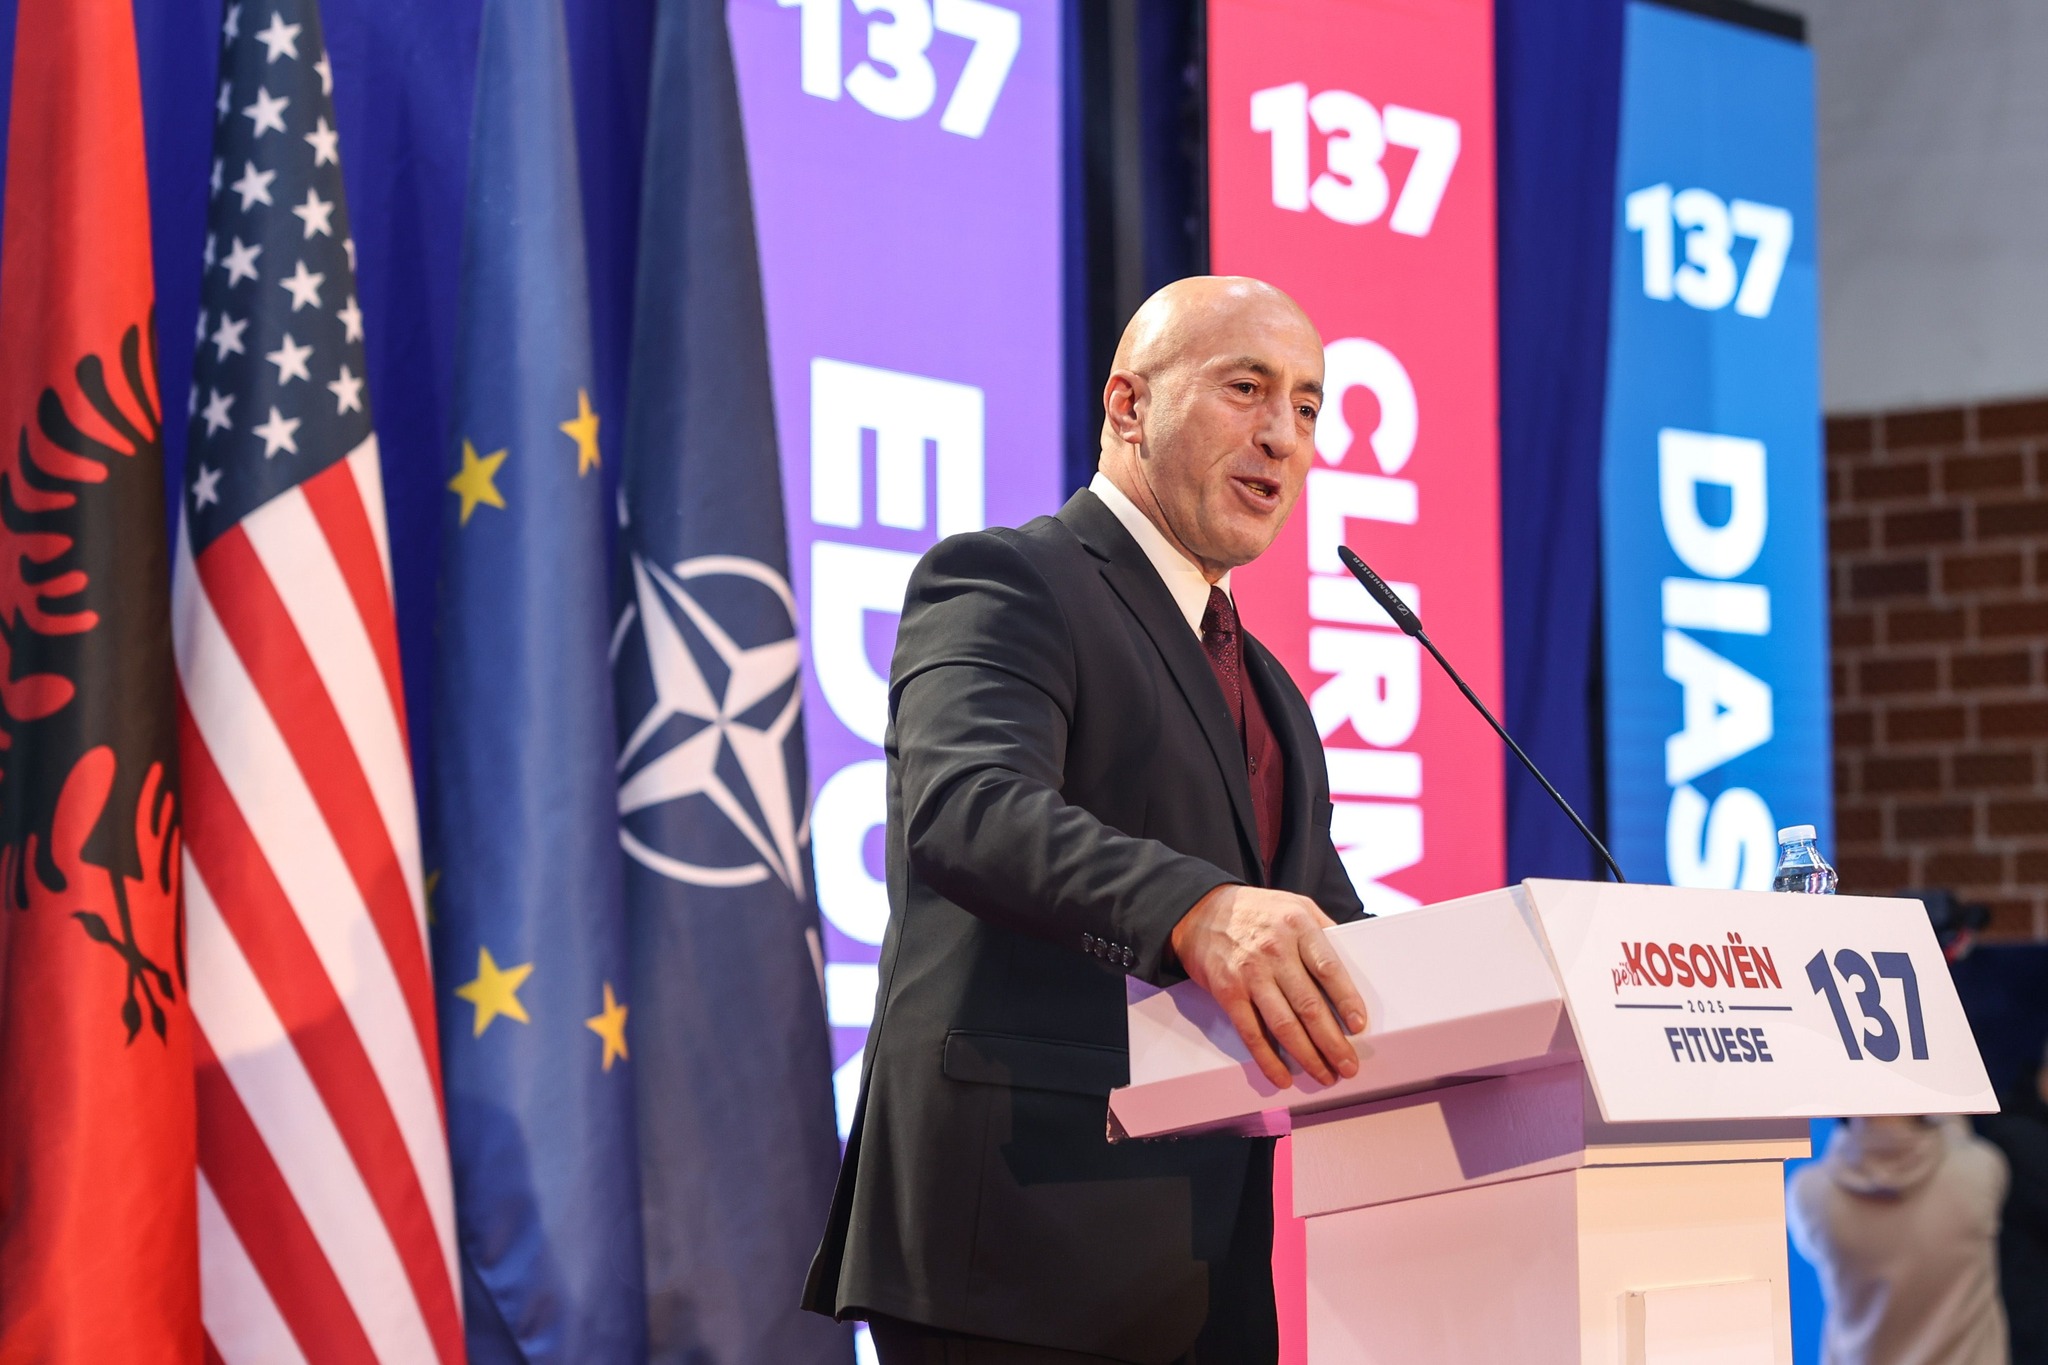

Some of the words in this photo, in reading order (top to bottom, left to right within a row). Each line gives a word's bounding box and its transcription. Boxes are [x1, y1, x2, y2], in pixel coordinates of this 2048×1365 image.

[777, 0, 1021, 139] 137
[1250, 81, 1461, 238] 137
[1625, 182, 1793, 319] 137
[1352, 556, 1399, 604] SENNHEISER
[1657, 426, 1777, 891] DIAS
[1621, 931, 1783, 989] KOSOVËN
[1687, 1000, 1725, 1013] 2025
[1805, 949, 1929, 1062] 137
[1664, 1027, 1774, 1063] FITUESE
